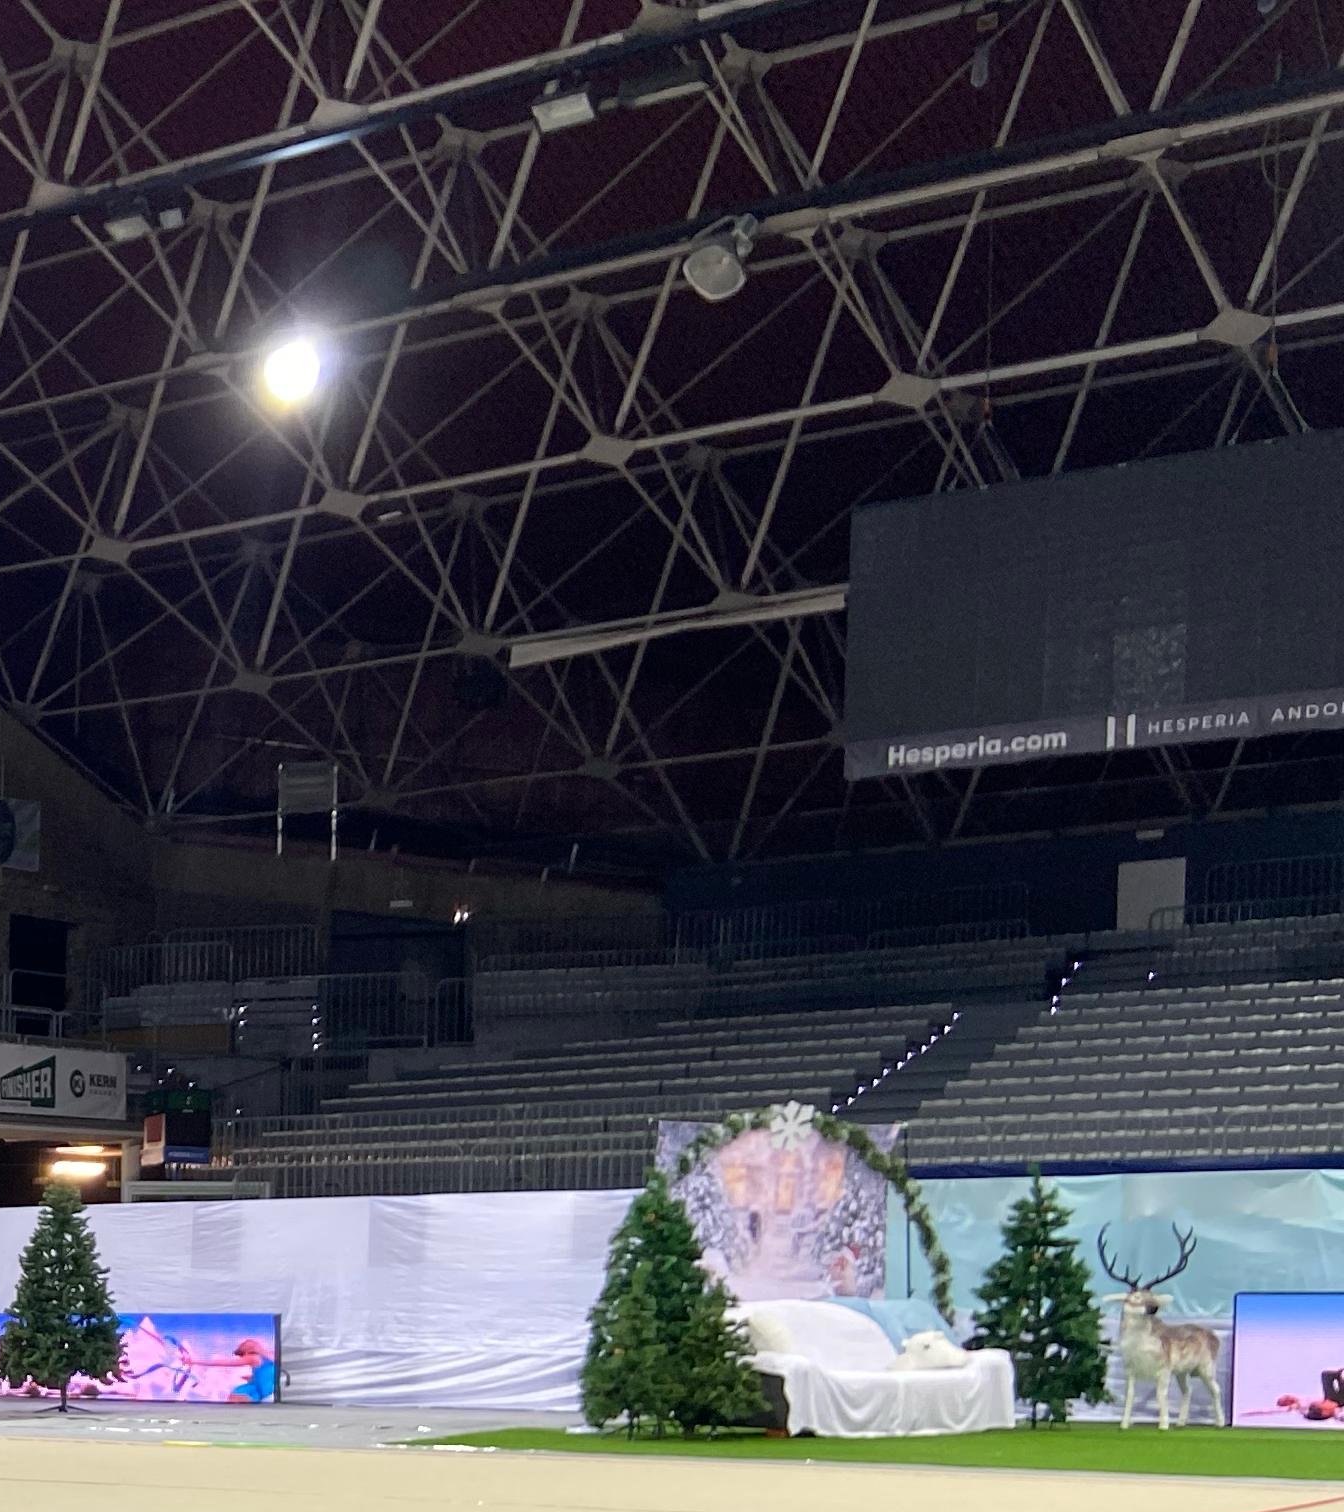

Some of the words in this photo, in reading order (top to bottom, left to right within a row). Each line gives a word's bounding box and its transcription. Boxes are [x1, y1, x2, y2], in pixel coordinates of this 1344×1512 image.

[1148, 711, 1251, 735] HESPERIA
[1271, 702, 1344, 723] ANDO
[888, 731, 1067, 767] Hesperia.com
